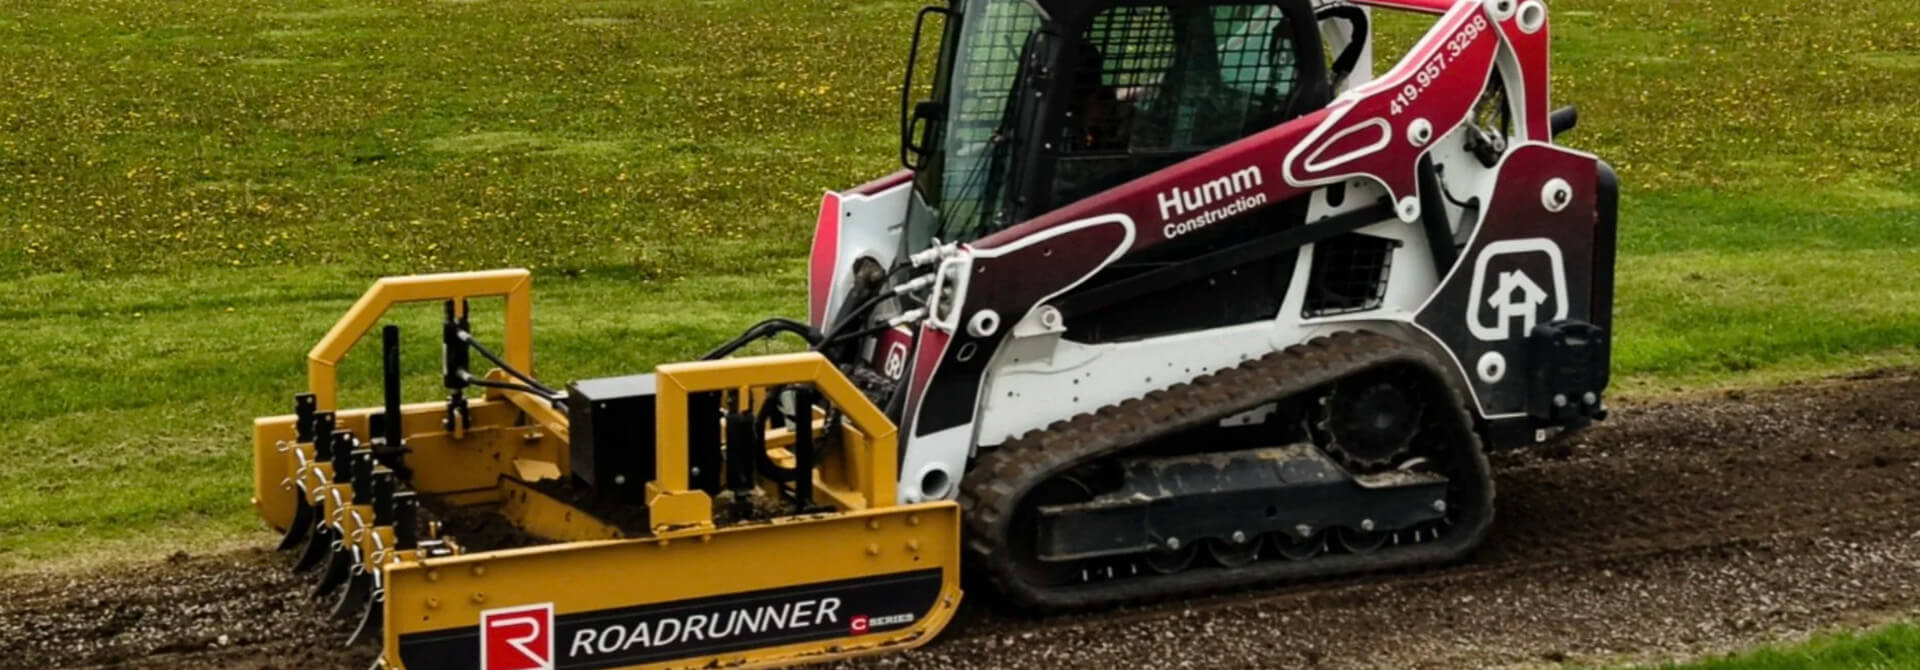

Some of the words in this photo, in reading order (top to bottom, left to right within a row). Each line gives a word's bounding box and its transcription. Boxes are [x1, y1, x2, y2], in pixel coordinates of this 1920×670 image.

[1390, 14, 1487, 116] 419.957.3298
[1157, 165, 1263, 220] Humm
[1163, 192, 1267, 239] Construction
[569, 596, 841, 657] ROADRUNNER
[852, 617, 868, 631] C
[869, 612, 915, 628] SERIES
